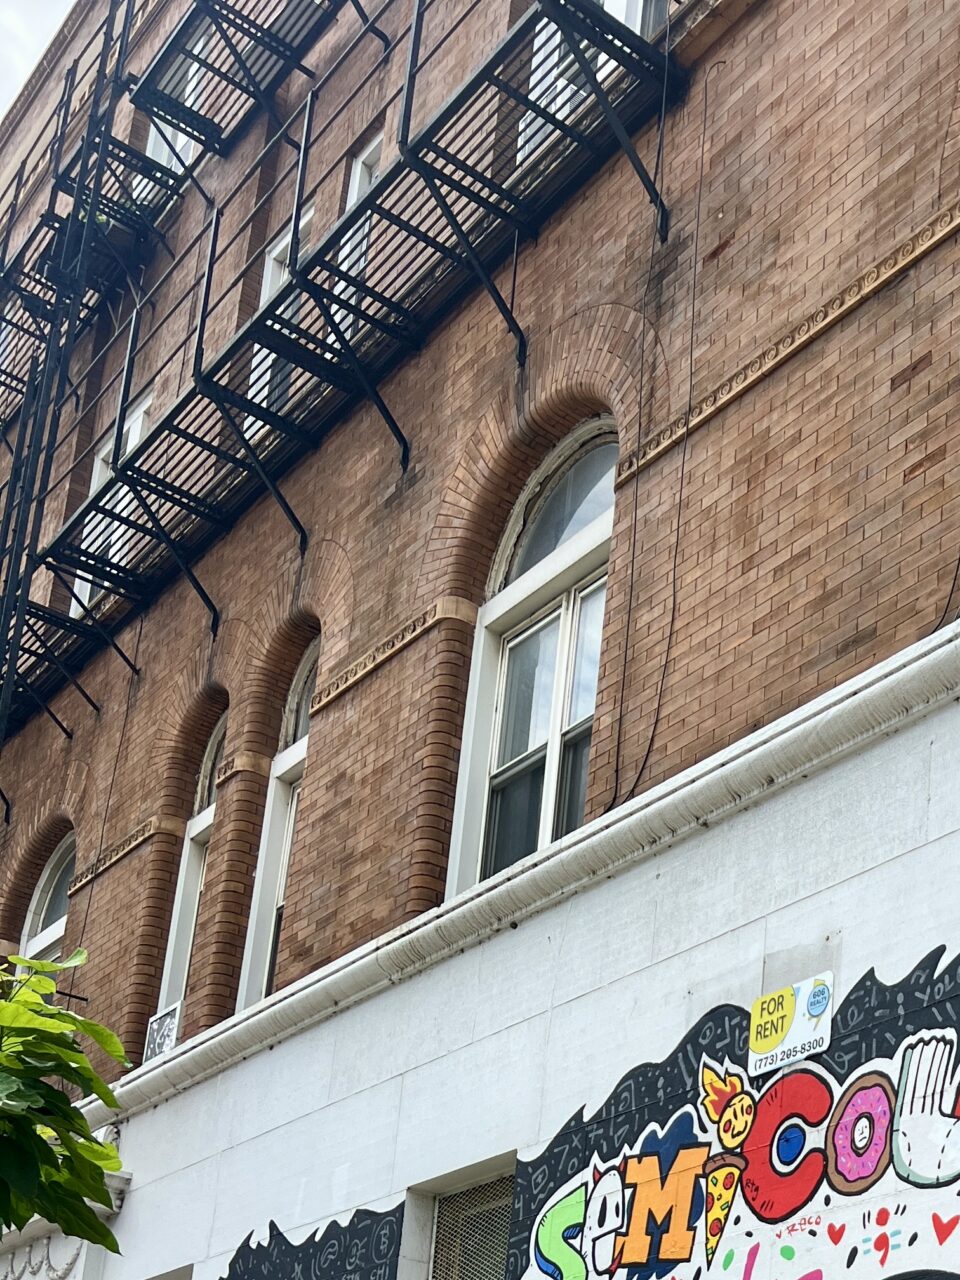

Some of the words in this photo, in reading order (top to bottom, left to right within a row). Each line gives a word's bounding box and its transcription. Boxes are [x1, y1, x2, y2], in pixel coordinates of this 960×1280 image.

[809, 996, 827, 1007] REALTY
[812, 987, 826, 999] 606
[760, 994, 785, 1019] FOR
[755, 1014, 787, 1042] RENT
[754, 1053, 779, 1072] (773)
